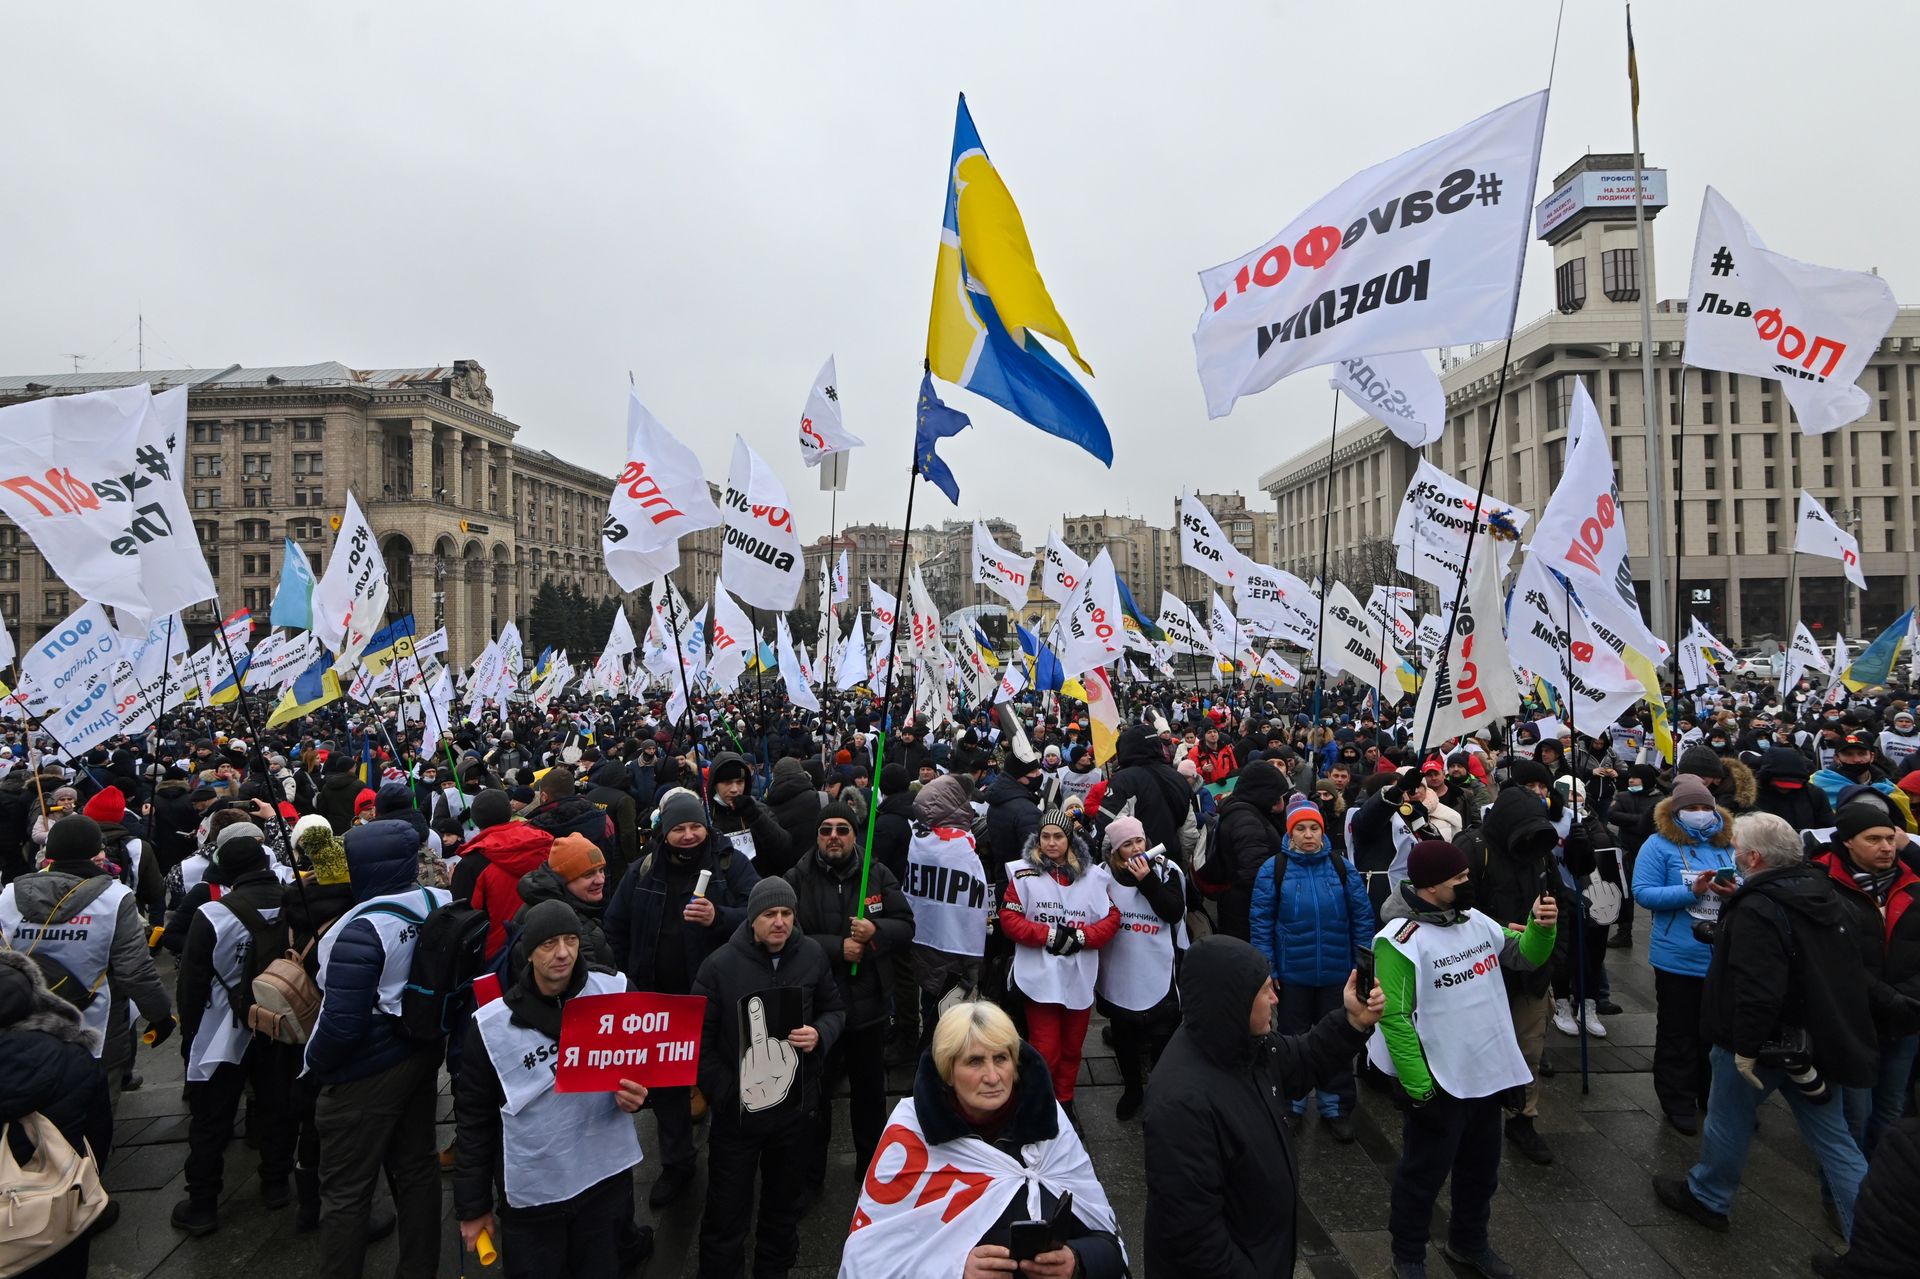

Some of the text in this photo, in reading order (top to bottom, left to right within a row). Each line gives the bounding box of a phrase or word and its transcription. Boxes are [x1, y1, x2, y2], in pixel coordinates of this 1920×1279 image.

[1432, 940, 1492, 970] ХМЕЛЬНИЧЧИНА
[1433, 953, 1499, 990] #SaveФОП
[597, 1011, 670, 1035] Я ФОП
[563, 1040, 695, 1070] Я проти ТІНІ
